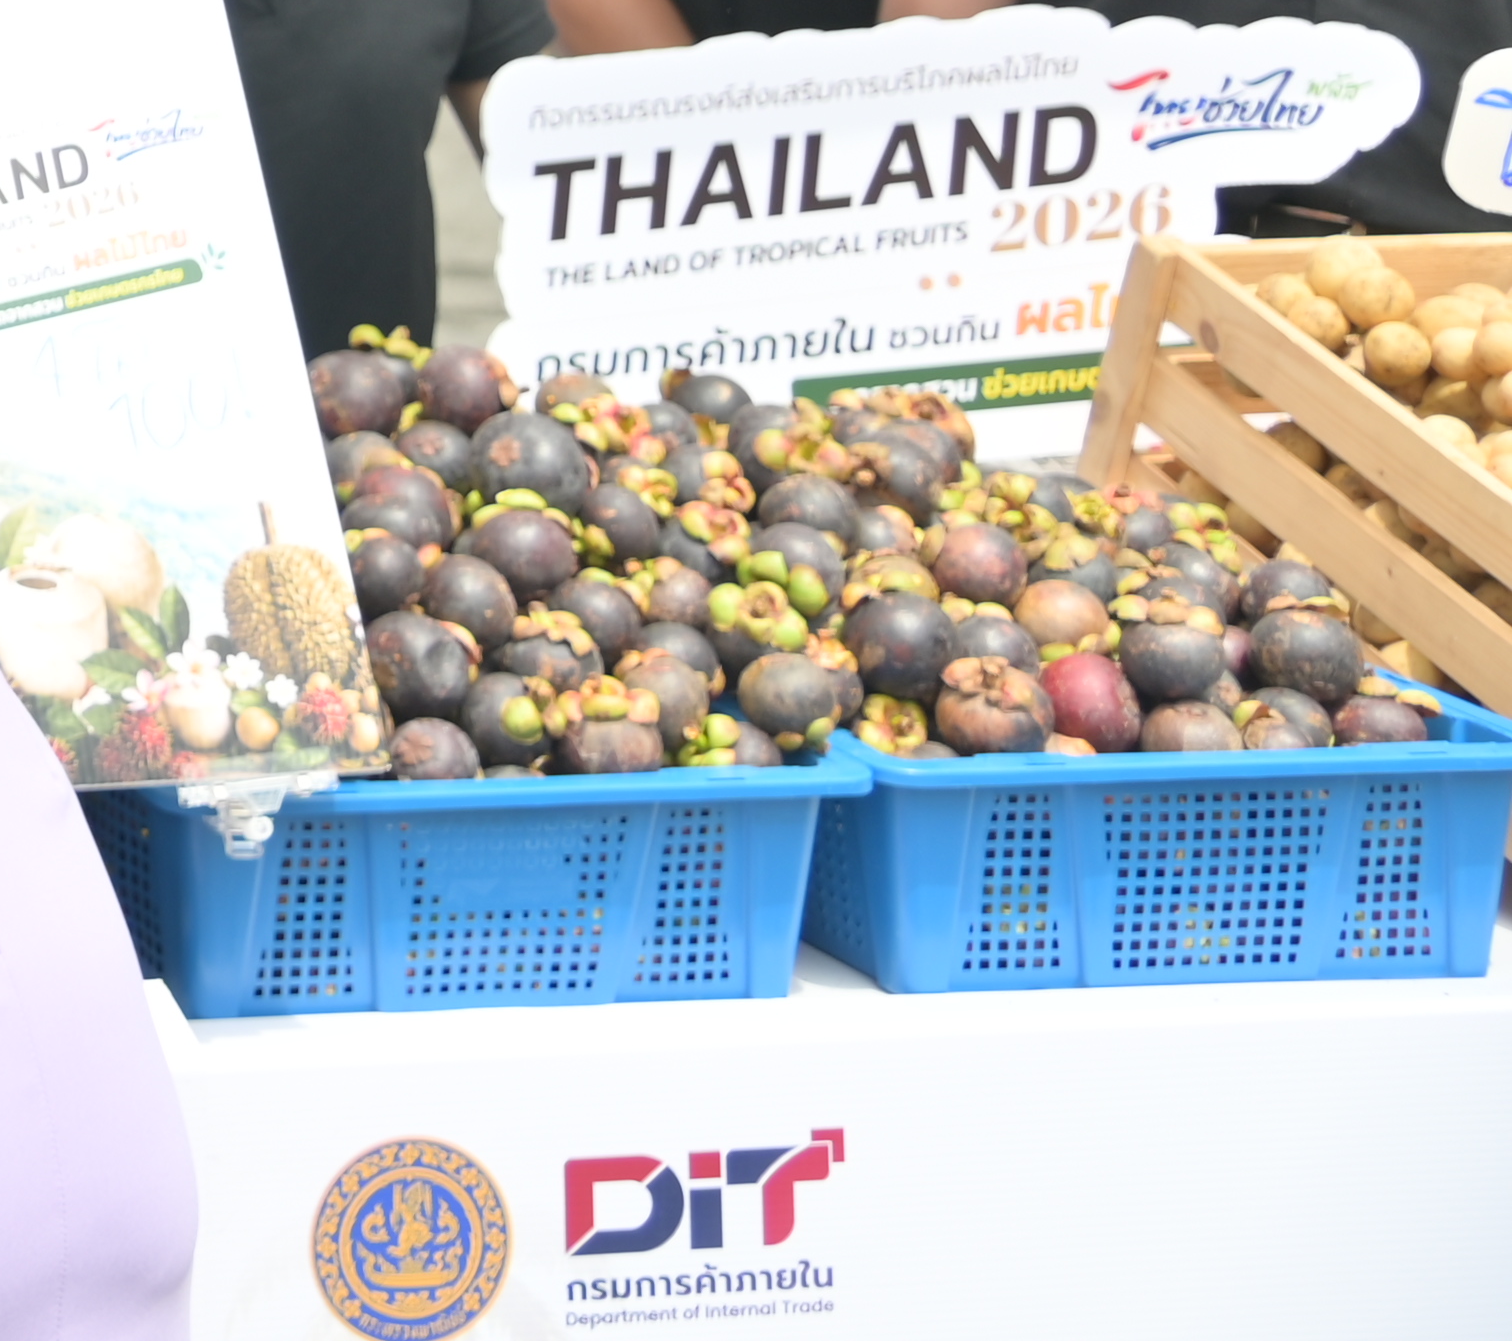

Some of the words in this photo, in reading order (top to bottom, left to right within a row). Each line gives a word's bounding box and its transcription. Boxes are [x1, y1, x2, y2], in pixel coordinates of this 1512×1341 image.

[43, 181, 141, 228] 2026
[533, 102, 1099, 241] THAILAND
[989, 183, 1174, 255] 2026
[545, 263, 596, 290] THE
[604, 254, 680, 282] LAND
[688, 246, 724, 272] OF
[734, 235, 865, 267] TROPICAL
[875, 219, 970, 251] FRUITS
[536, 318, 876, 383] กรมการค้าภายใน
[890, 315, 1001, 350] ชวนกิน
[565, 1257, 835, 1303] กรมการค้าภายใน
[565, 1308, 678, 1330] Department
[682, 1304, 700, 1321] of
[704, 1299, 777, 1319] Internal
[782, 1296, 835, 1316] Trade
